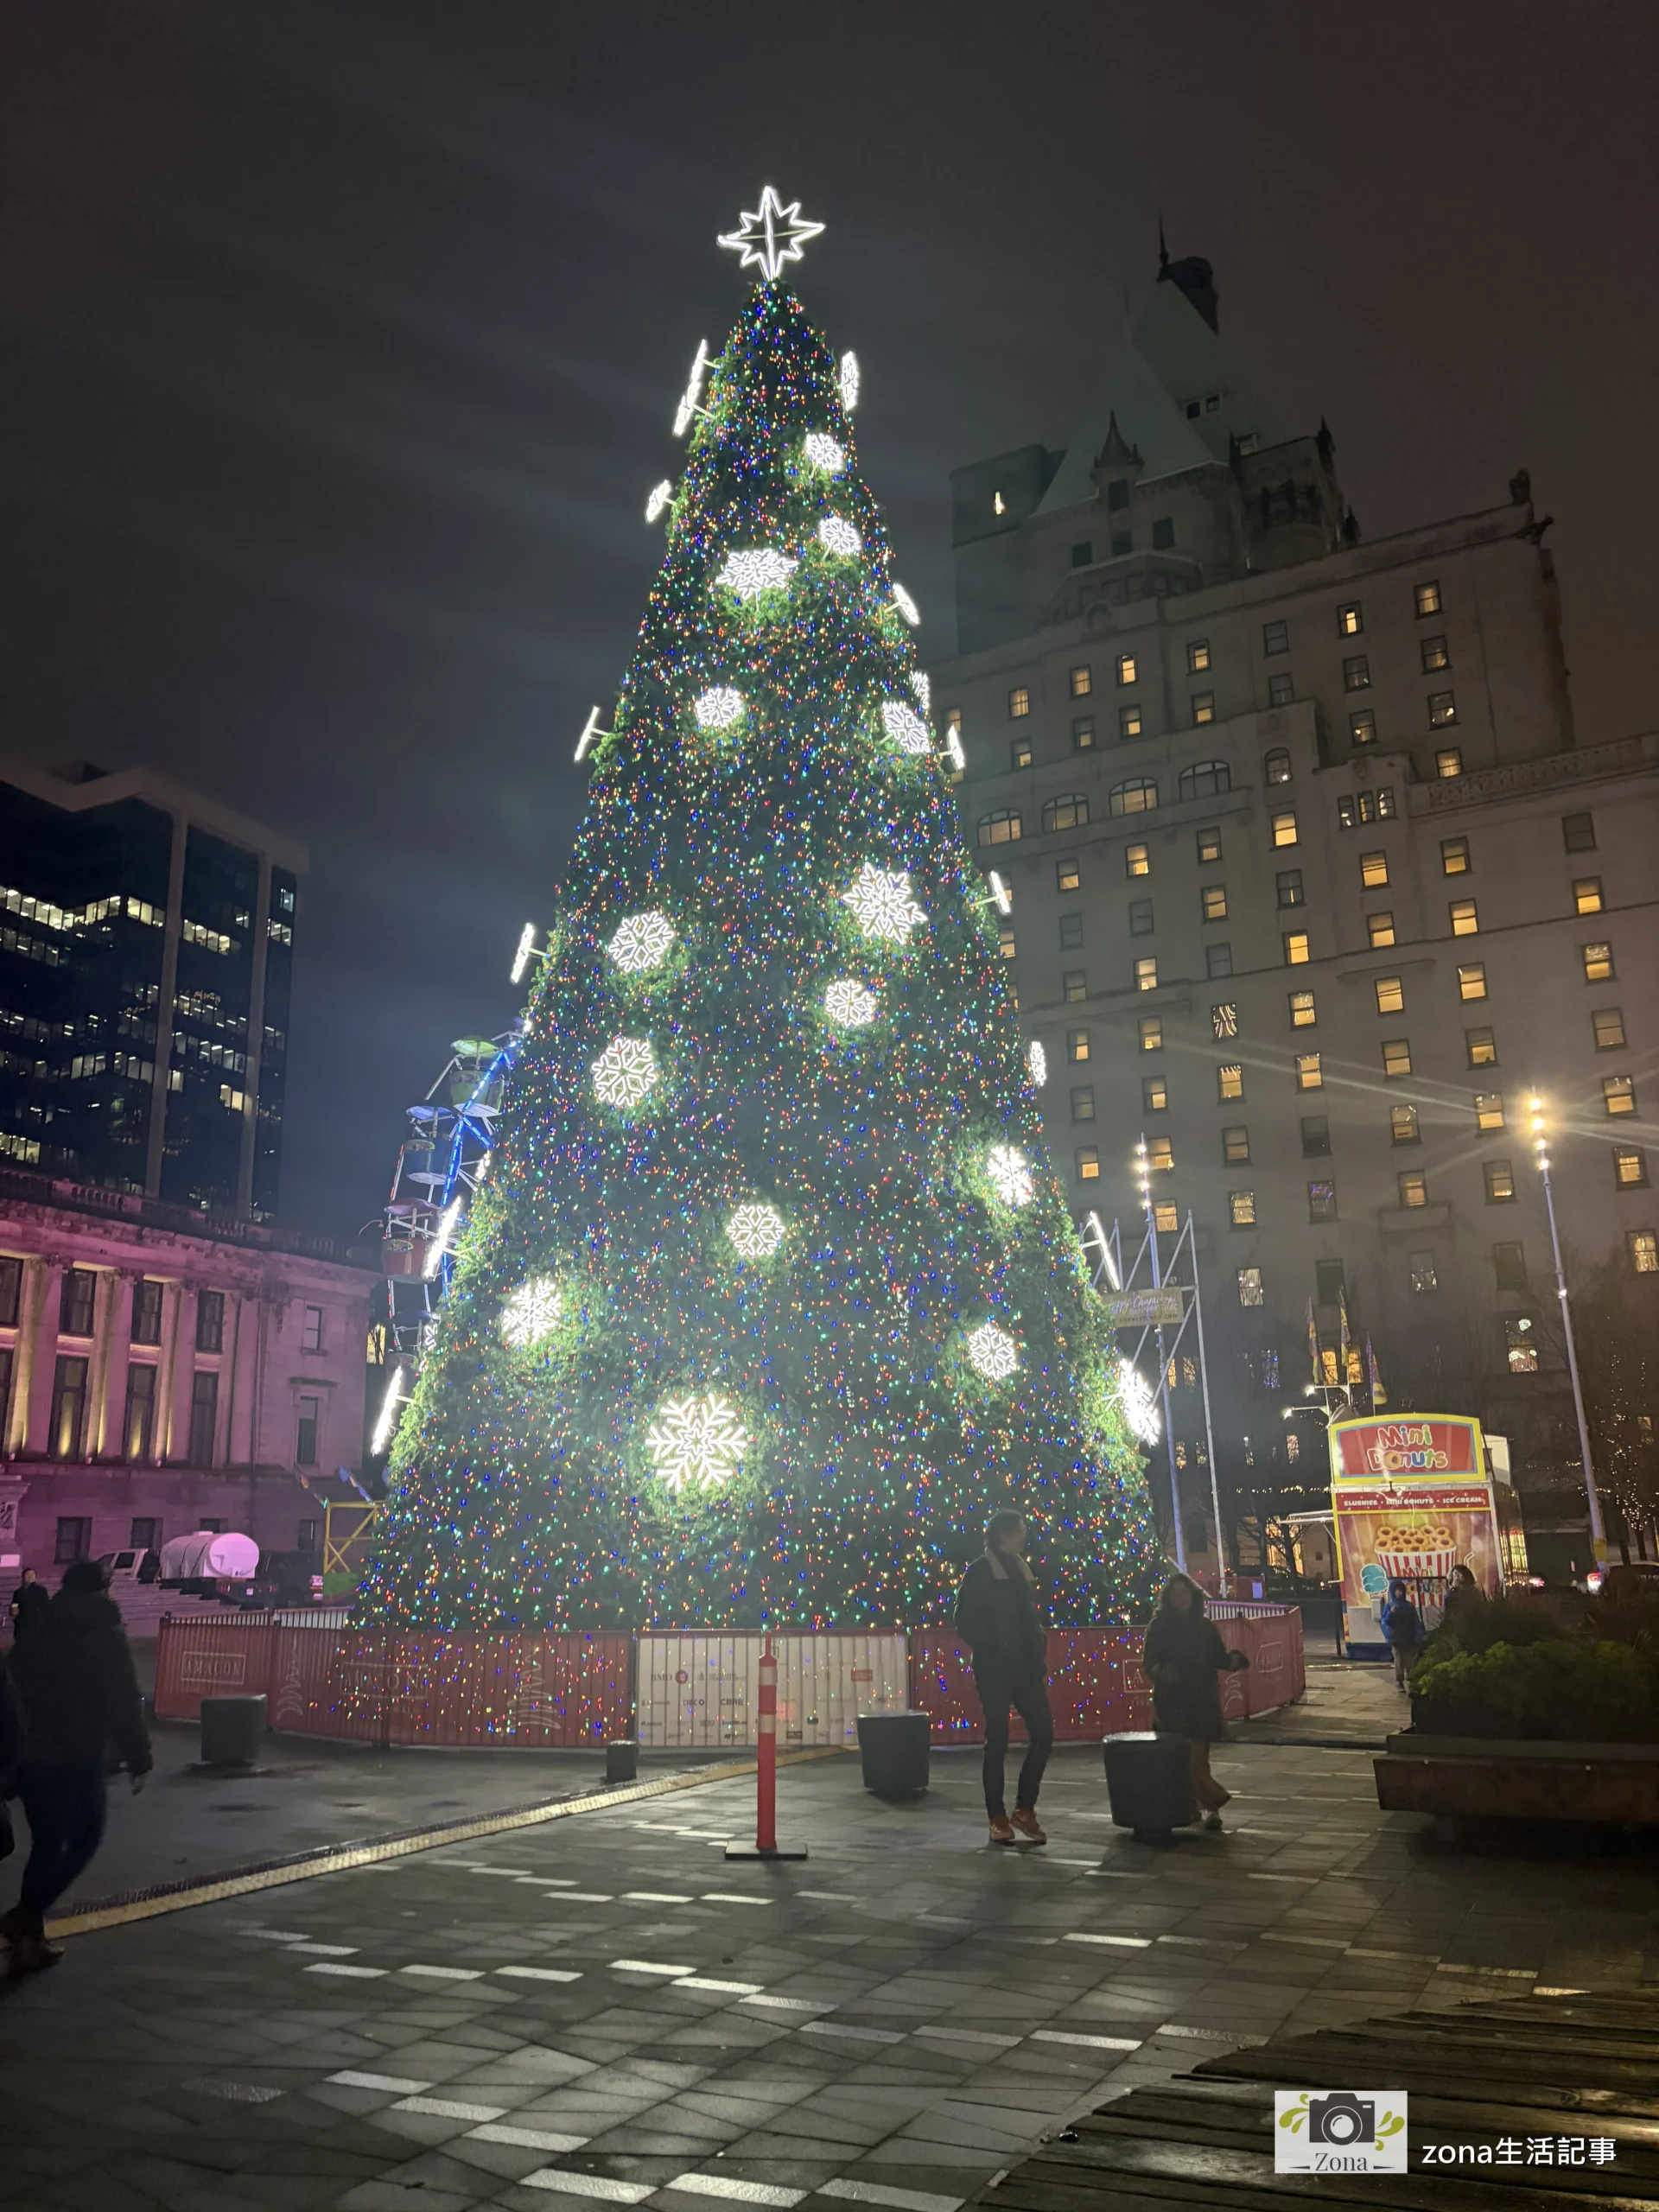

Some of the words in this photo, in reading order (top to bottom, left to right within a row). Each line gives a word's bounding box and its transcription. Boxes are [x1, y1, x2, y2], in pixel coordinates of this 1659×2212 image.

[1377, 1424, 1433, 1449] Mini
[1367, 1448, 1448, 1471] Donuts
[1455, 1496, 1482, 1504] CREAM
